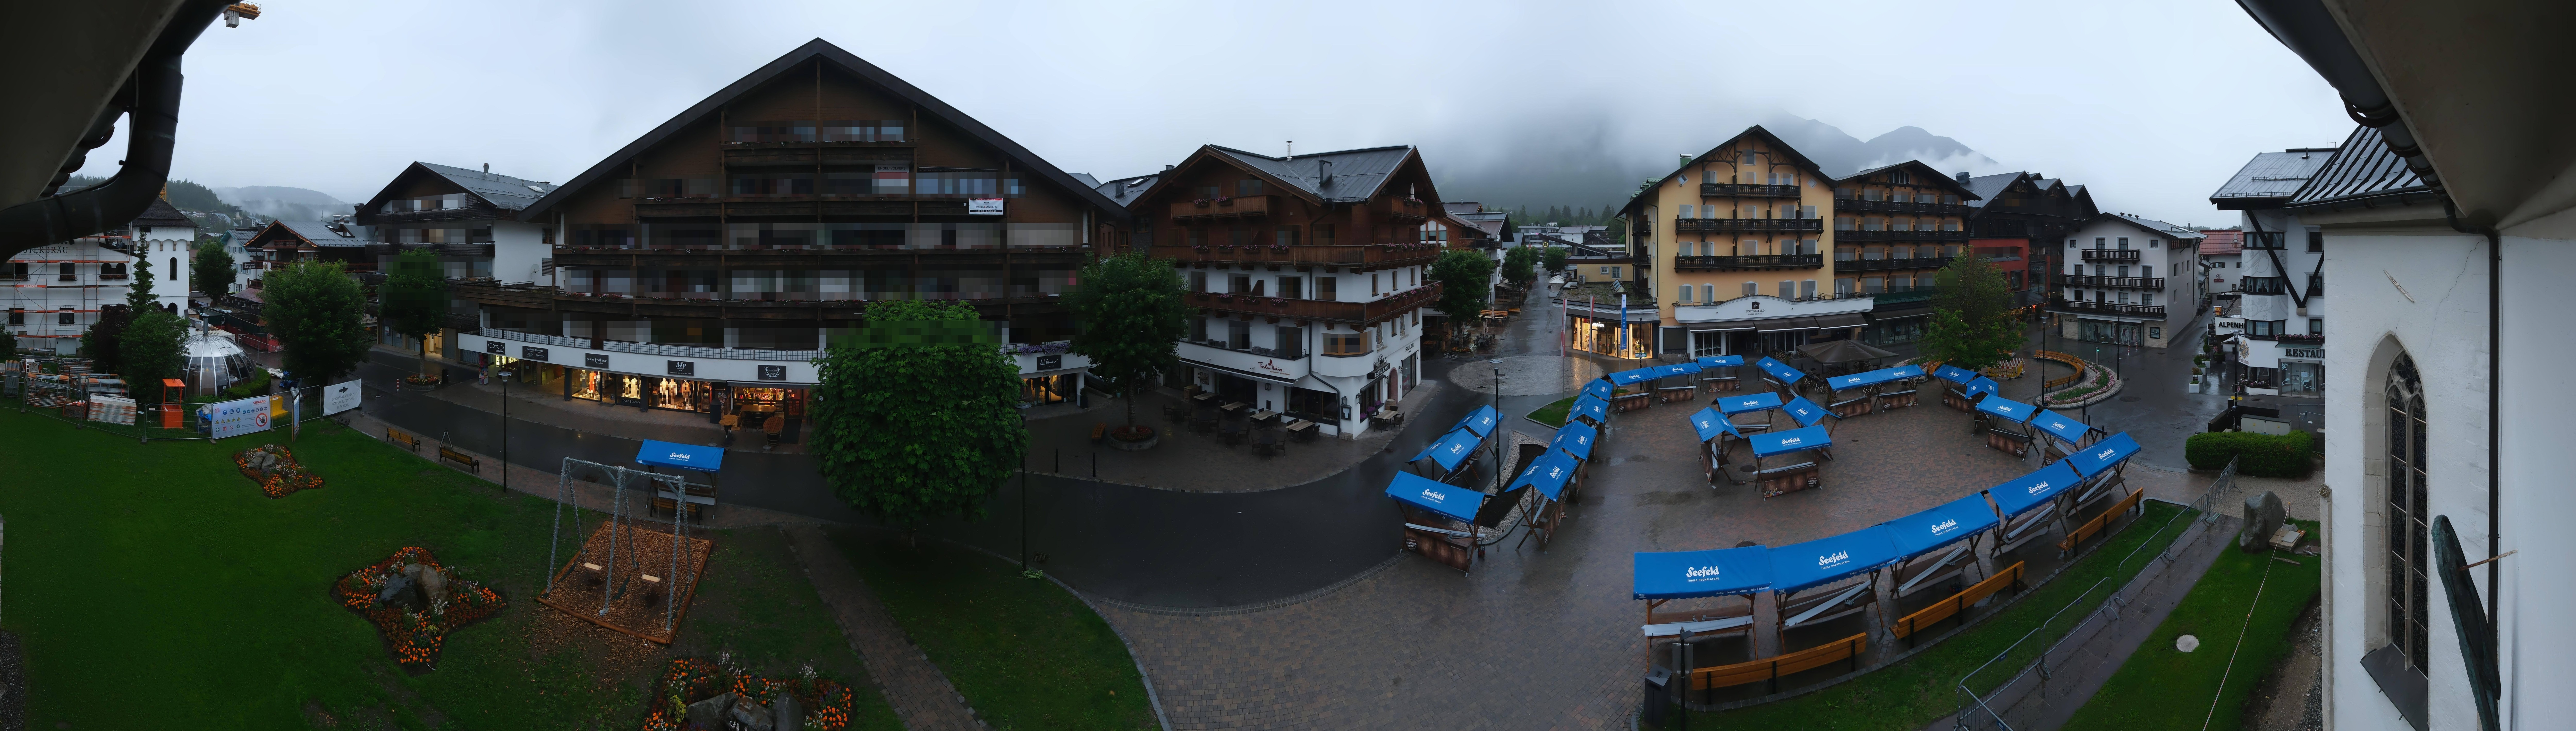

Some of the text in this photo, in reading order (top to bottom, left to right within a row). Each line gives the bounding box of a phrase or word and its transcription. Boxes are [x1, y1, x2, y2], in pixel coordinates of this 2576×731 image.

[1405, 343, 1414, 352] SAILER
[1375, 364, 1389, 377] RESTAURANT
[332, 397, 354, 406] KONGRESSZENTRUM
[1451, 443, 1462, 453] Seefeld
[2098, 448, 2114, 459] Seefeld
[1549, 466, 1560, 478] Seefeld
[2029, 481, 2048, 494] Seefeld
[1422, 489, 1445, 500] Seefeld
[1932, 519, 1956, 533] Seefeld
[1819, 550, 1848, 566] Seefeld
[1686, 565, 1719, 577] Seefeld
